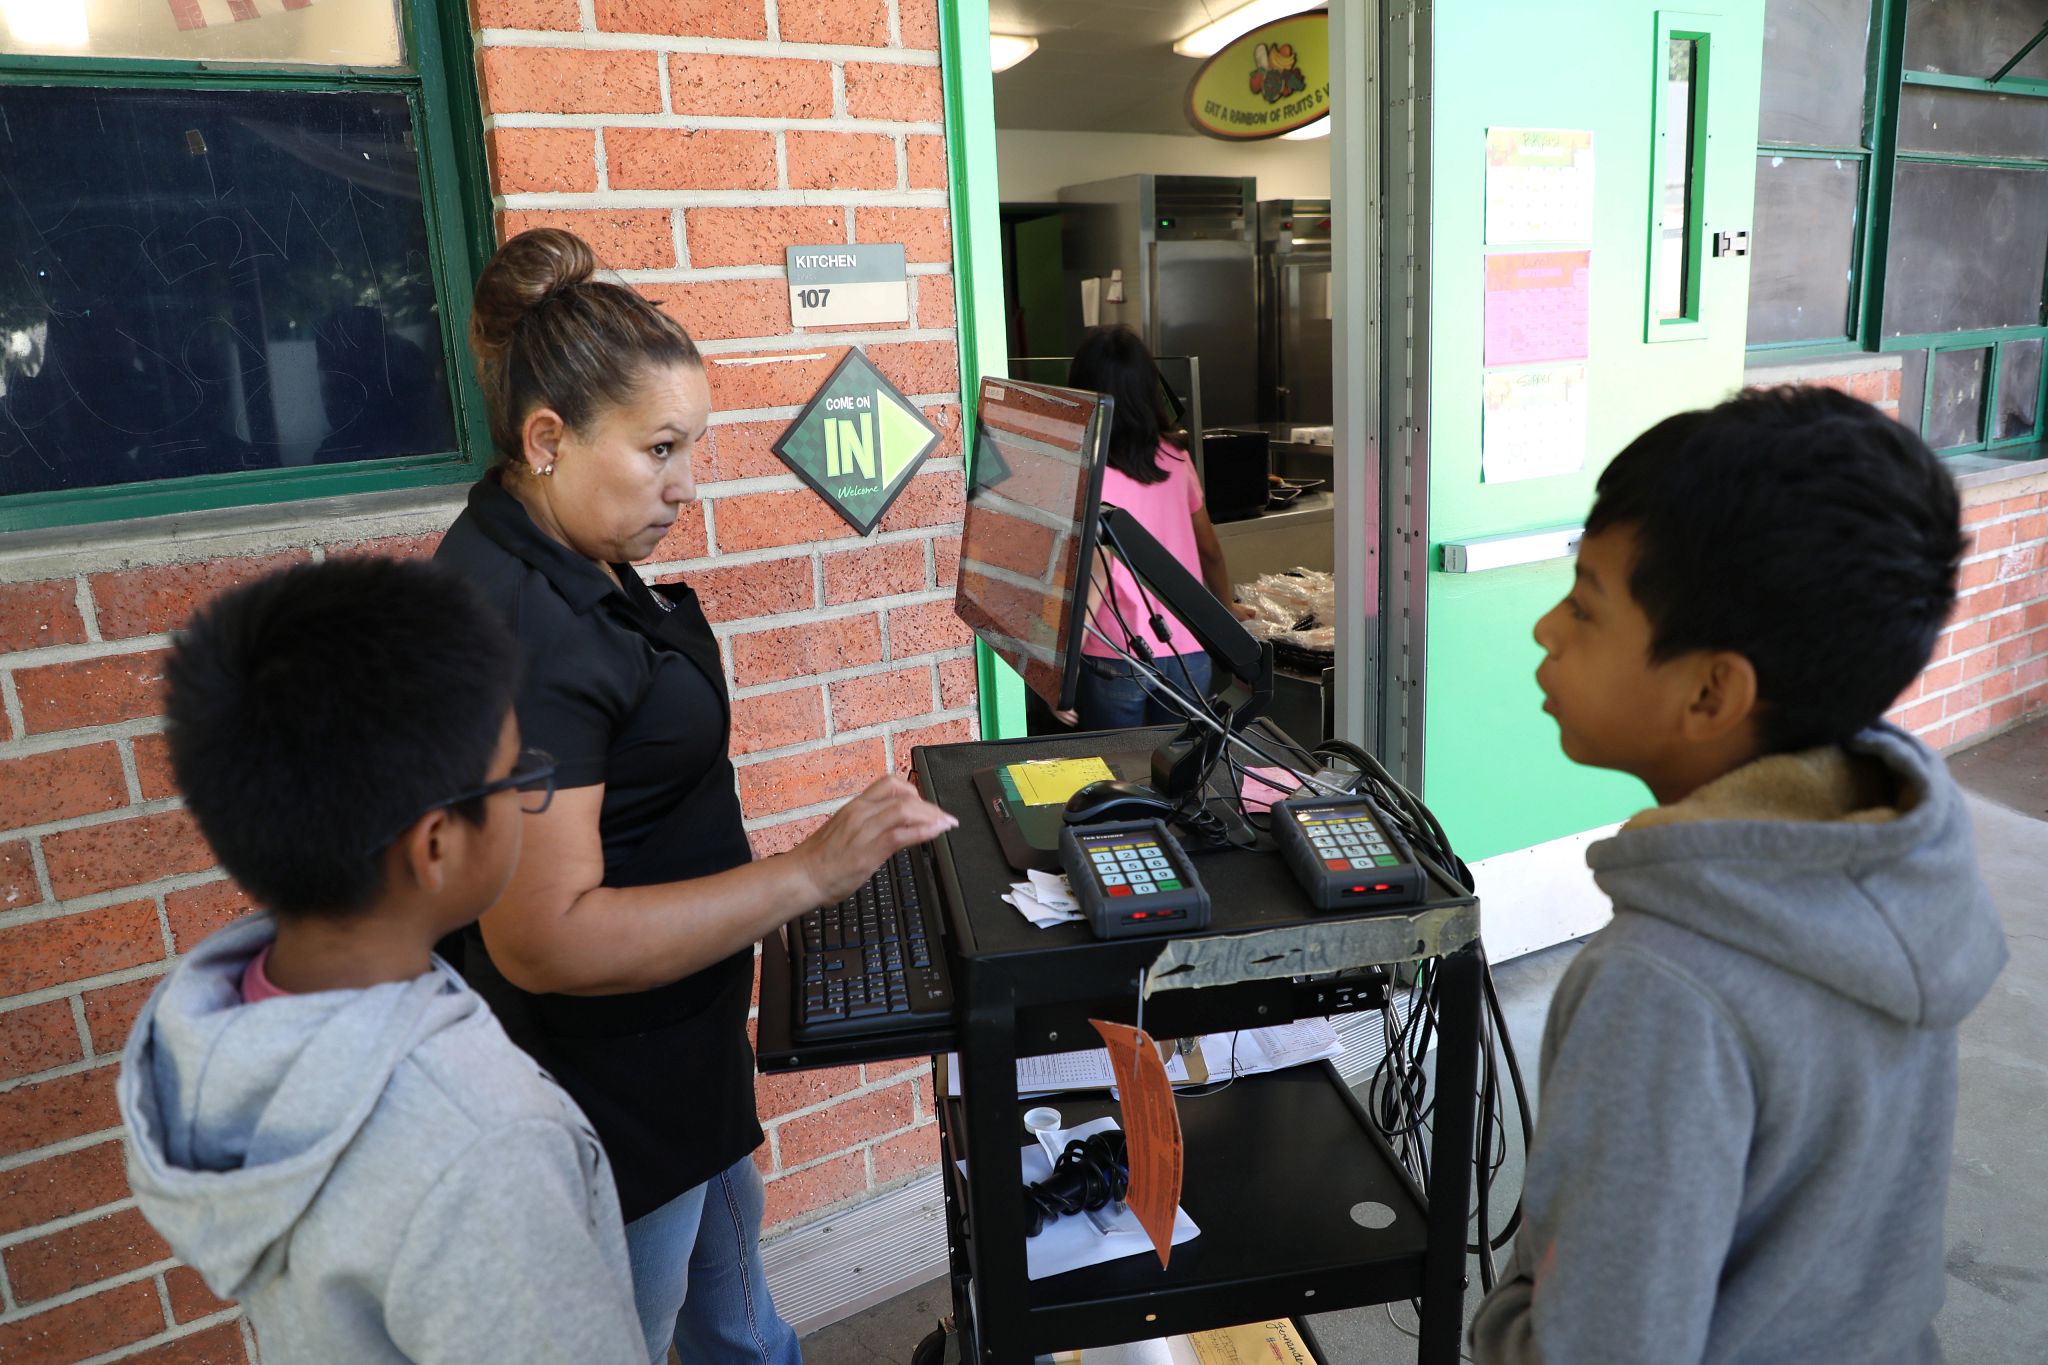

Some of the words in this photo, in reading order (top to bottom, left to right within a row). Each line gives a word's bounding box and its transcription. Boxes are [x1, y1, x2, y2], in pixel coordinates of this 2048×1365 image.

[1204, 100, 1222, 117] EAT
[1221, 107, 1228, 120] A
[1230, 110, 1268, 125] RAINBOW
[1270, 108, 1281, 122] OF
[1283, 94, 1314, 119] FRUITS
[1314, 89, 1322, 103] &
[795, 254, 857, 269] KITCHEN
[797, 288, 831, 309] 107
[825, 396, 855, 411] COME
[856, 395, 871, 409] ON
[823, 412, 876, 480] IN
[837, 485, 879, 499] Welcome
